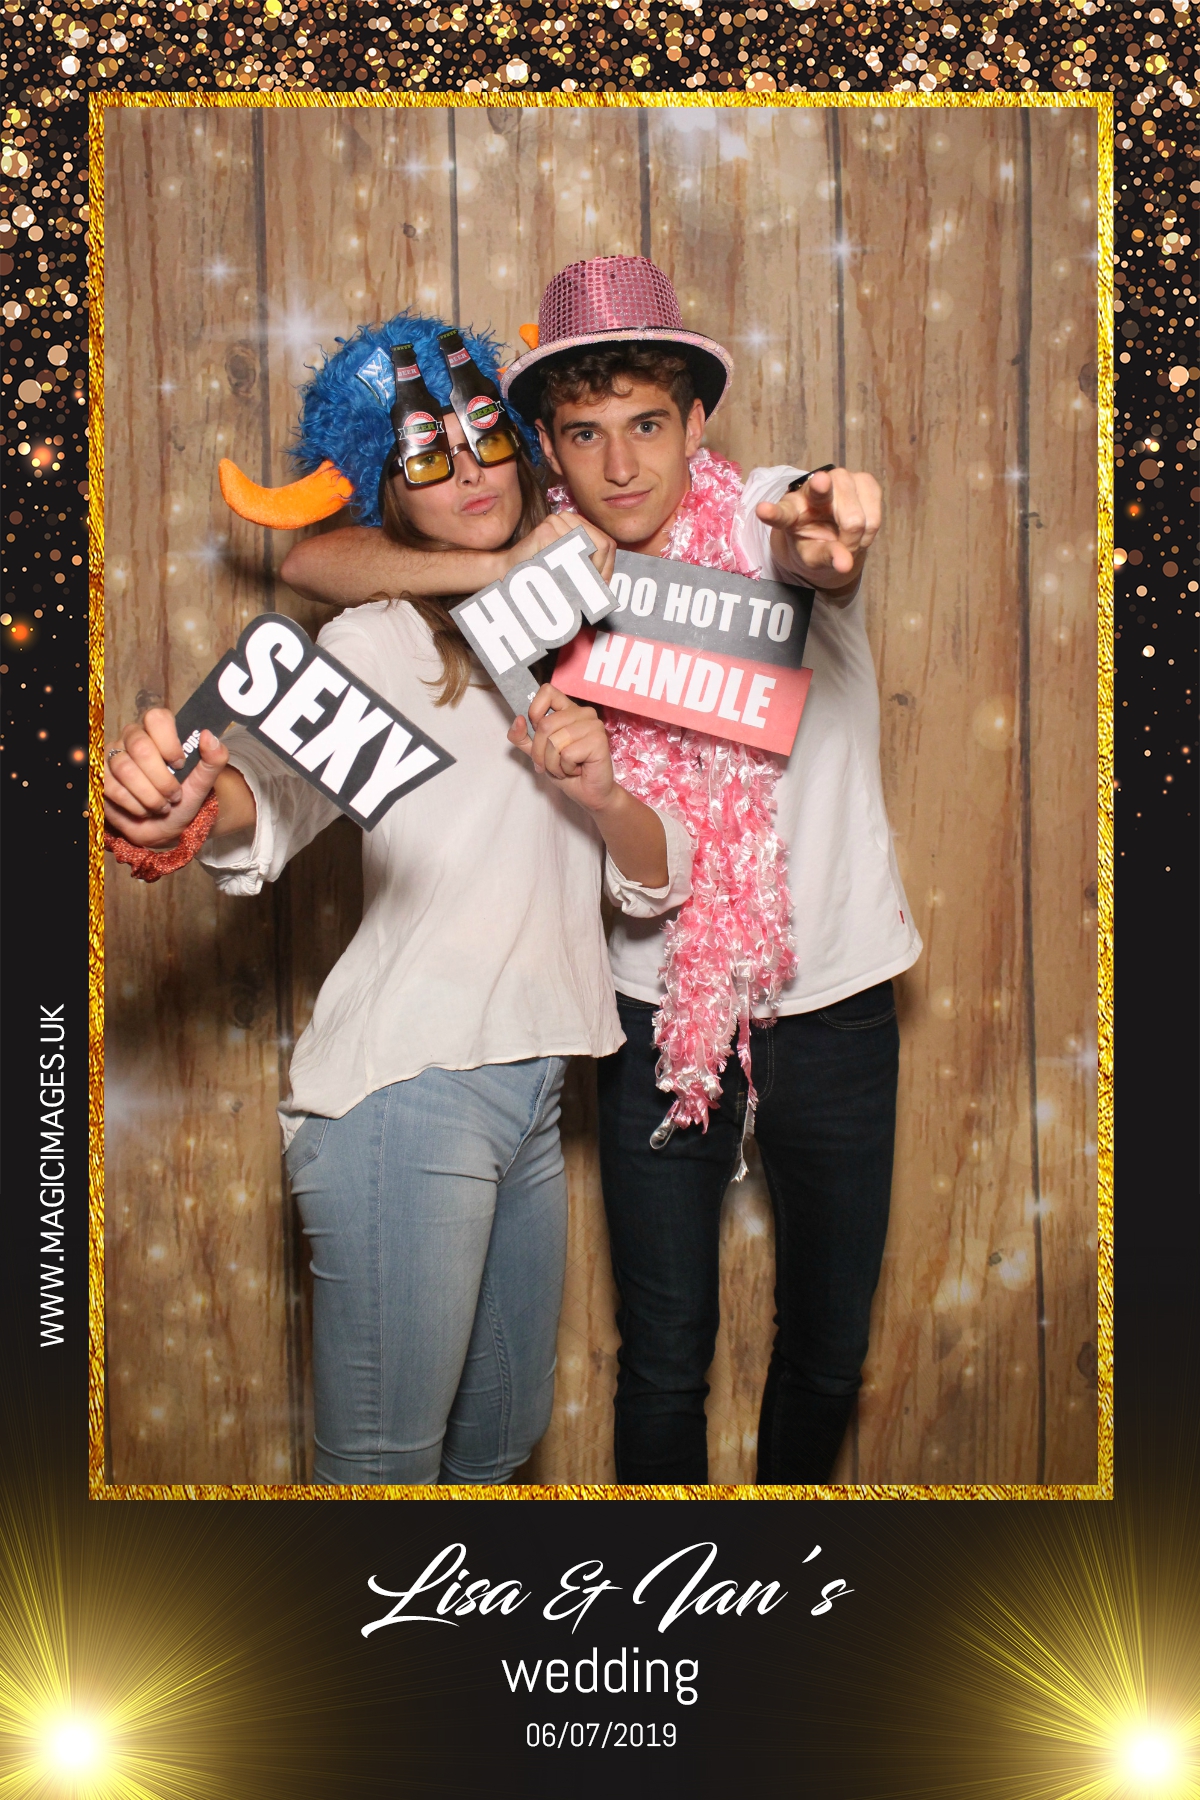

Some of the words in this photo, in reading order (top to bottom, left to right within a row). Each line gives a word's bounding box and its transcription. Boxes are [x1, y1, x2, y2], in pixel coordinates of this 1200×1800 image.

[397, 368, 417, 377] BEER
[448, 352, 467, 363] BEER
[406, 422, 436, 434] BEER
[470, 404, 497, 420] BEER
[459, 534, 612, 675] HOT
[608, 572, 658, 617] OO
[663, 582, 742, 632] HOT
[747, 596, 795, 643] TO
[583, 630, 777, 729] HANDLE
[218, 622, 440, 819] SEXY
